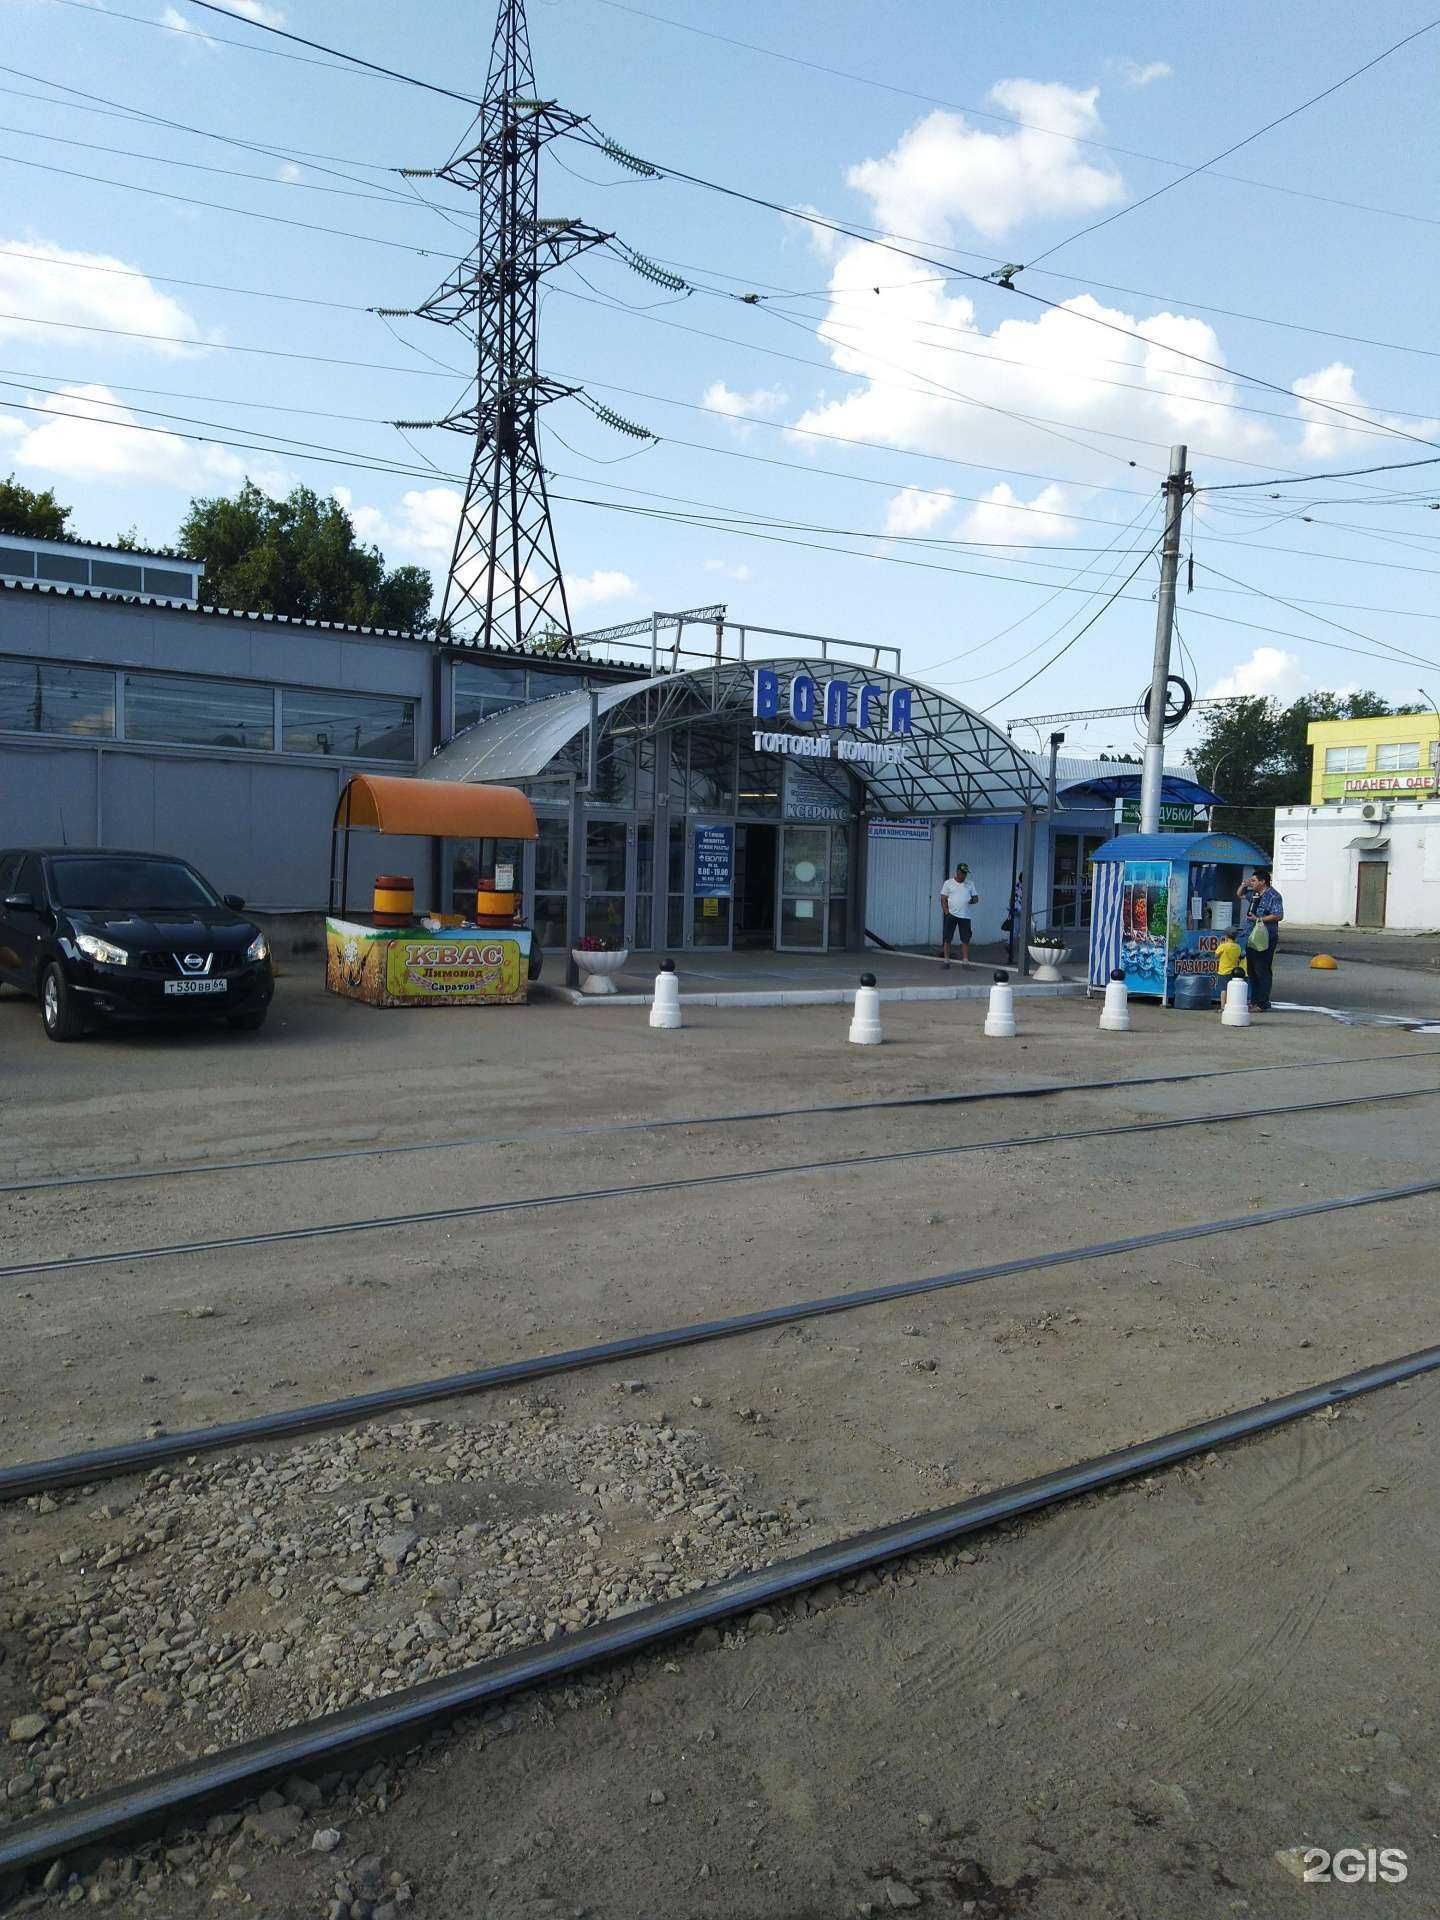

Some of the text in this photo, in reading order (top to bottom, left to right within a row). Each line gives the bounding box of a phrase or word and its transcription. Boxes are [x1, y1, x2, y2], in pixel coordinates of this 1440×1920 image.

[753, 669, 912, 735] ВОЛГА
[752, 731, 908, 764] ТОРГОВЫЙ КОМПЛЕКС
[1345, 777, 1400, 790] ПЛАНЕТА
[786, 804, 849, 821] КСЕРОКС
[1159, 806, 1192, 822] ДУБКИ
[405, 945, 504, 967] КВАС
[423, 968, 483, 978] Лимонад
[431, 982, 476, 993] Саратов
